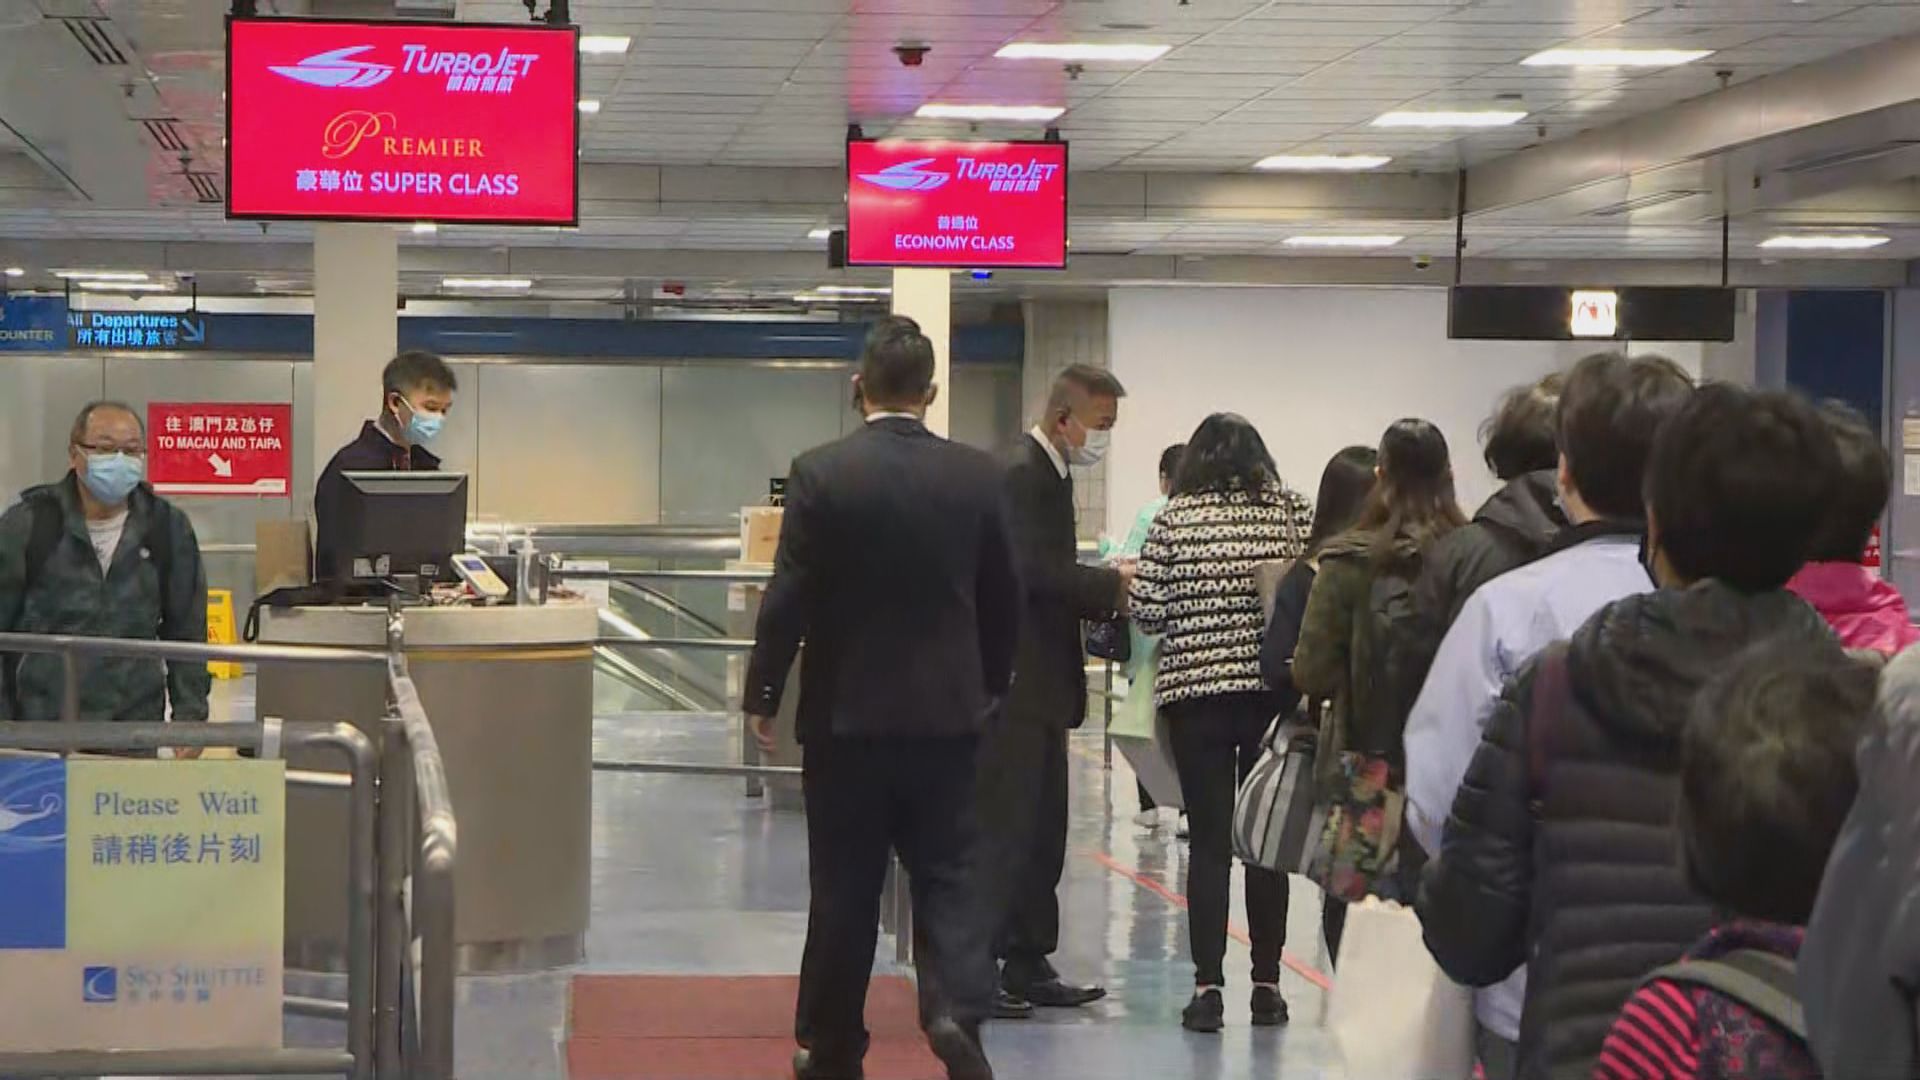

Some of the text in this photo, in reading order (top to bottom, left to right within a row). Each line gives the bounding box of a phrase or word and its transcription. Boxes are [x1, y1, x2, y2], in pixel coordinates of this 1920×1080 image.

[321, 110, 485, 160] PREMIER
[369, 171, 443, 193] SUPER
[448, 173, 519, 196] CLASS
[895, 234, 1015, 250] ECONOMY CLASS
[91, 313, 178, 328] Departures
[158, 436, 282, 450] TO MACAU AND TAIPA
[94, 791, 259, 815] Please Wait
[92, 833, 261, 864] 請稍後片刻
